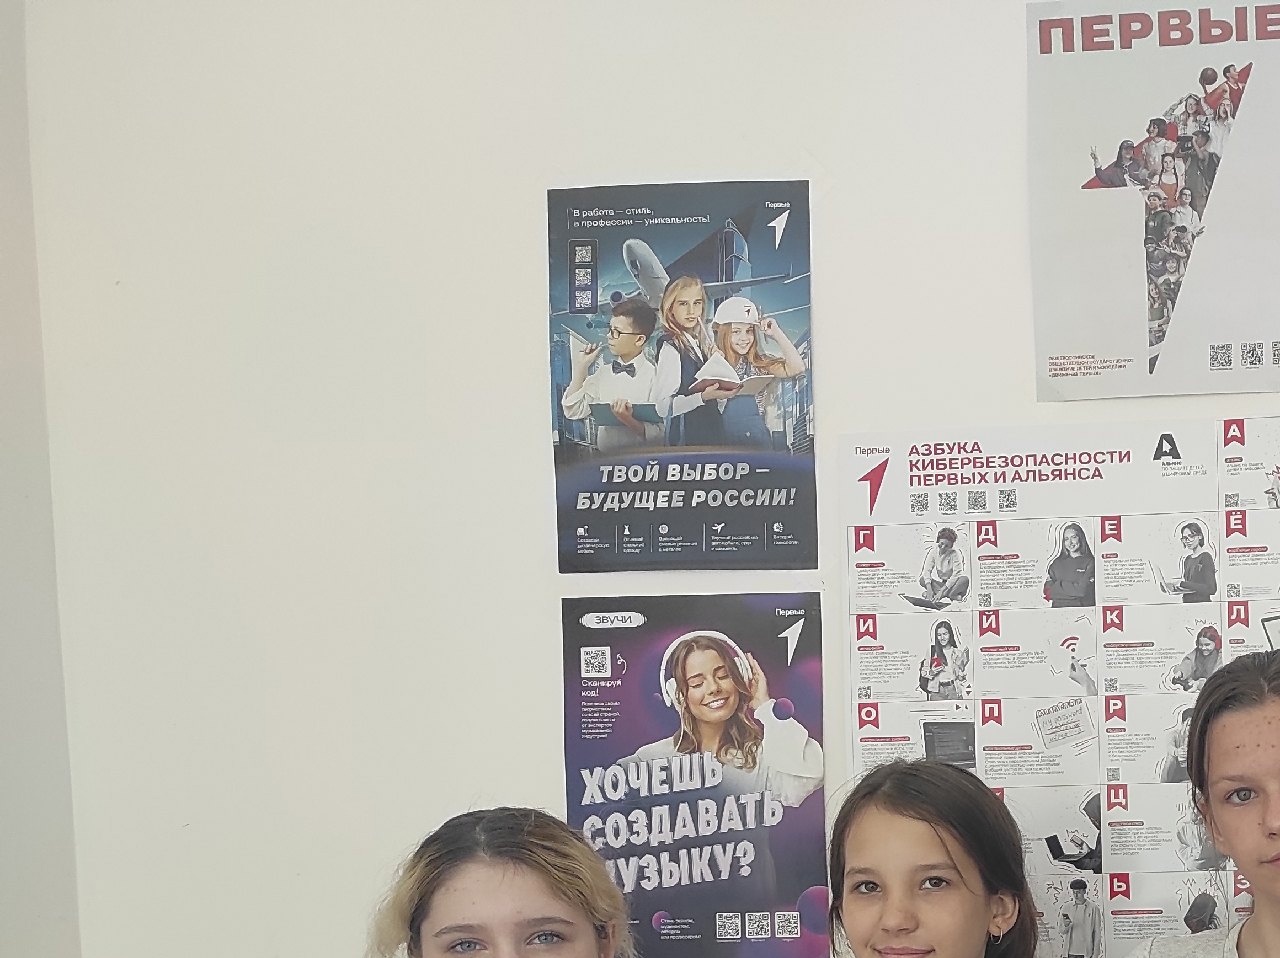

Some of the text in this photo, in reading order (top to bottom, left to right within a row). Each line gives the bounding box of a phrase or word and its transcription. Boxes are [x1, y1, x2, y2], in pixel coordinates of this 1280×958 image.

[573, 209, 580, 217] В
[581, 218, 633, 228] профессии
[643, 215, 711, 226] уникальность!
[908, 442, 983, 457] АЗБУКА
[600, 460, 659, 483] ТВОЙ
[667, 462, 750, 482] ВЫБОР
[908, 450, 1131, 473] КИБЕРБЕЗОПАСНОСТИ
[909, 467, 1104, 487] ПЕРВЫХ И АЛЬЯНСА
[576, 487, 797, 512] БУДУЩЕЕ РОССИИ!
[594, 615, 632, 626] ЗВУЧИ
[775, 608, 805, 617] Первые
[580, 752, 723, 806] ХОЧЕШЬ
[583, 789, 784, 851] СОЗДАВАТЬ
